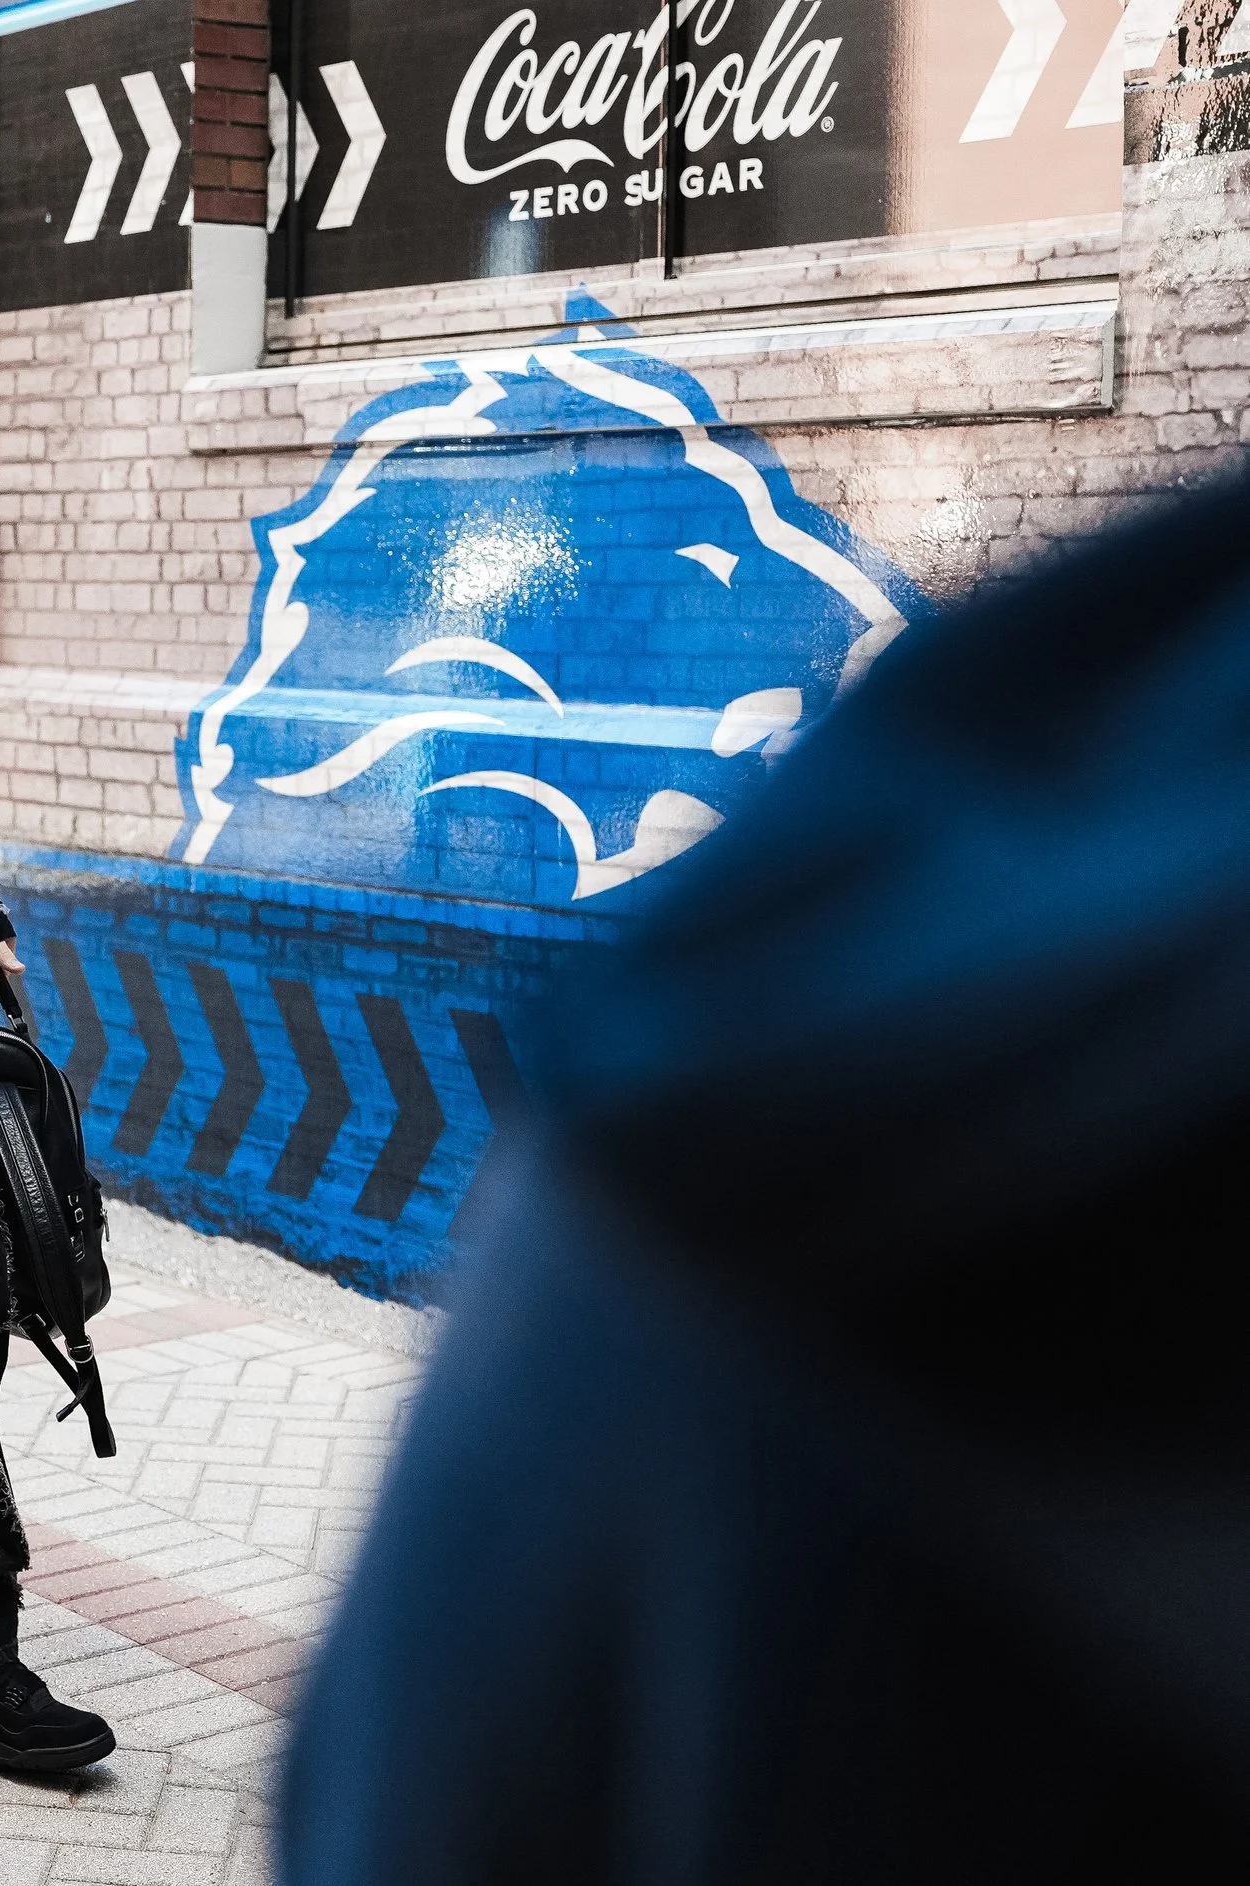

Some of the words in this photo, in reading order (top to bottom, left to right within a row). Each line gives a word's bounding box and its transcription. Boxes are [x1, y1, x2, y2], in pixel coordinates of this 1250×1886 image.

[445, 0, 843, 184] Coca-Cola
[508, 178, 608, 222] ZERO
[623, 157, 764, 207] SUGAR
